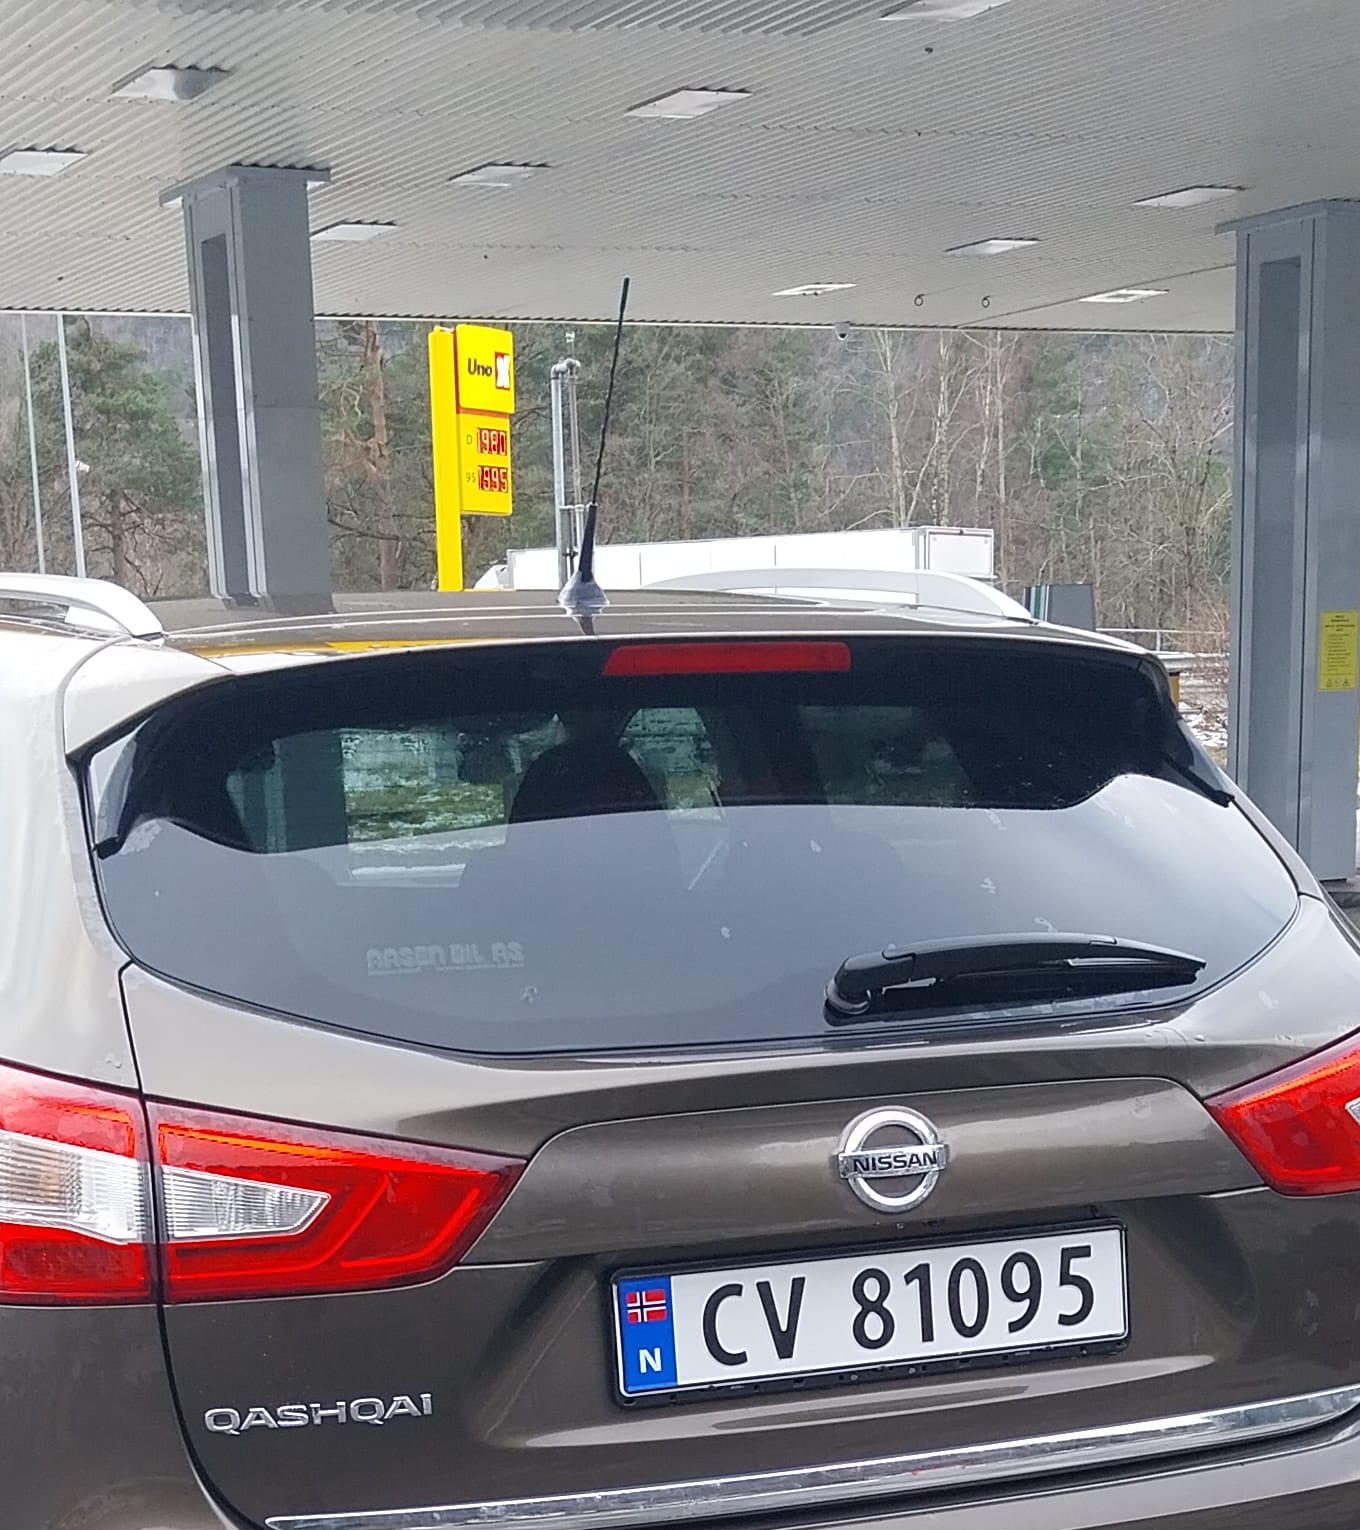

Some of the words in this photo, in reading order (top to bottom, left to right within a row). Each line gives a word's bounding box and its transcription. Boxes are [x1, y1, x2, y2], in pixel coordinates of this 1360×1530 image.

[467, 357, 493, 377] Uno
[466, 434, 473, 446] D
[466, 471, 477, 484] 95
[852, 1151, 939, 1174] NISSAN
[701, 1276, 807, 1367] CV
[851, 1243, 1096, 1350] 81095
[638, 1345, 663, 1375] N
[203, 1392, 435, 1436] QASHQAI
